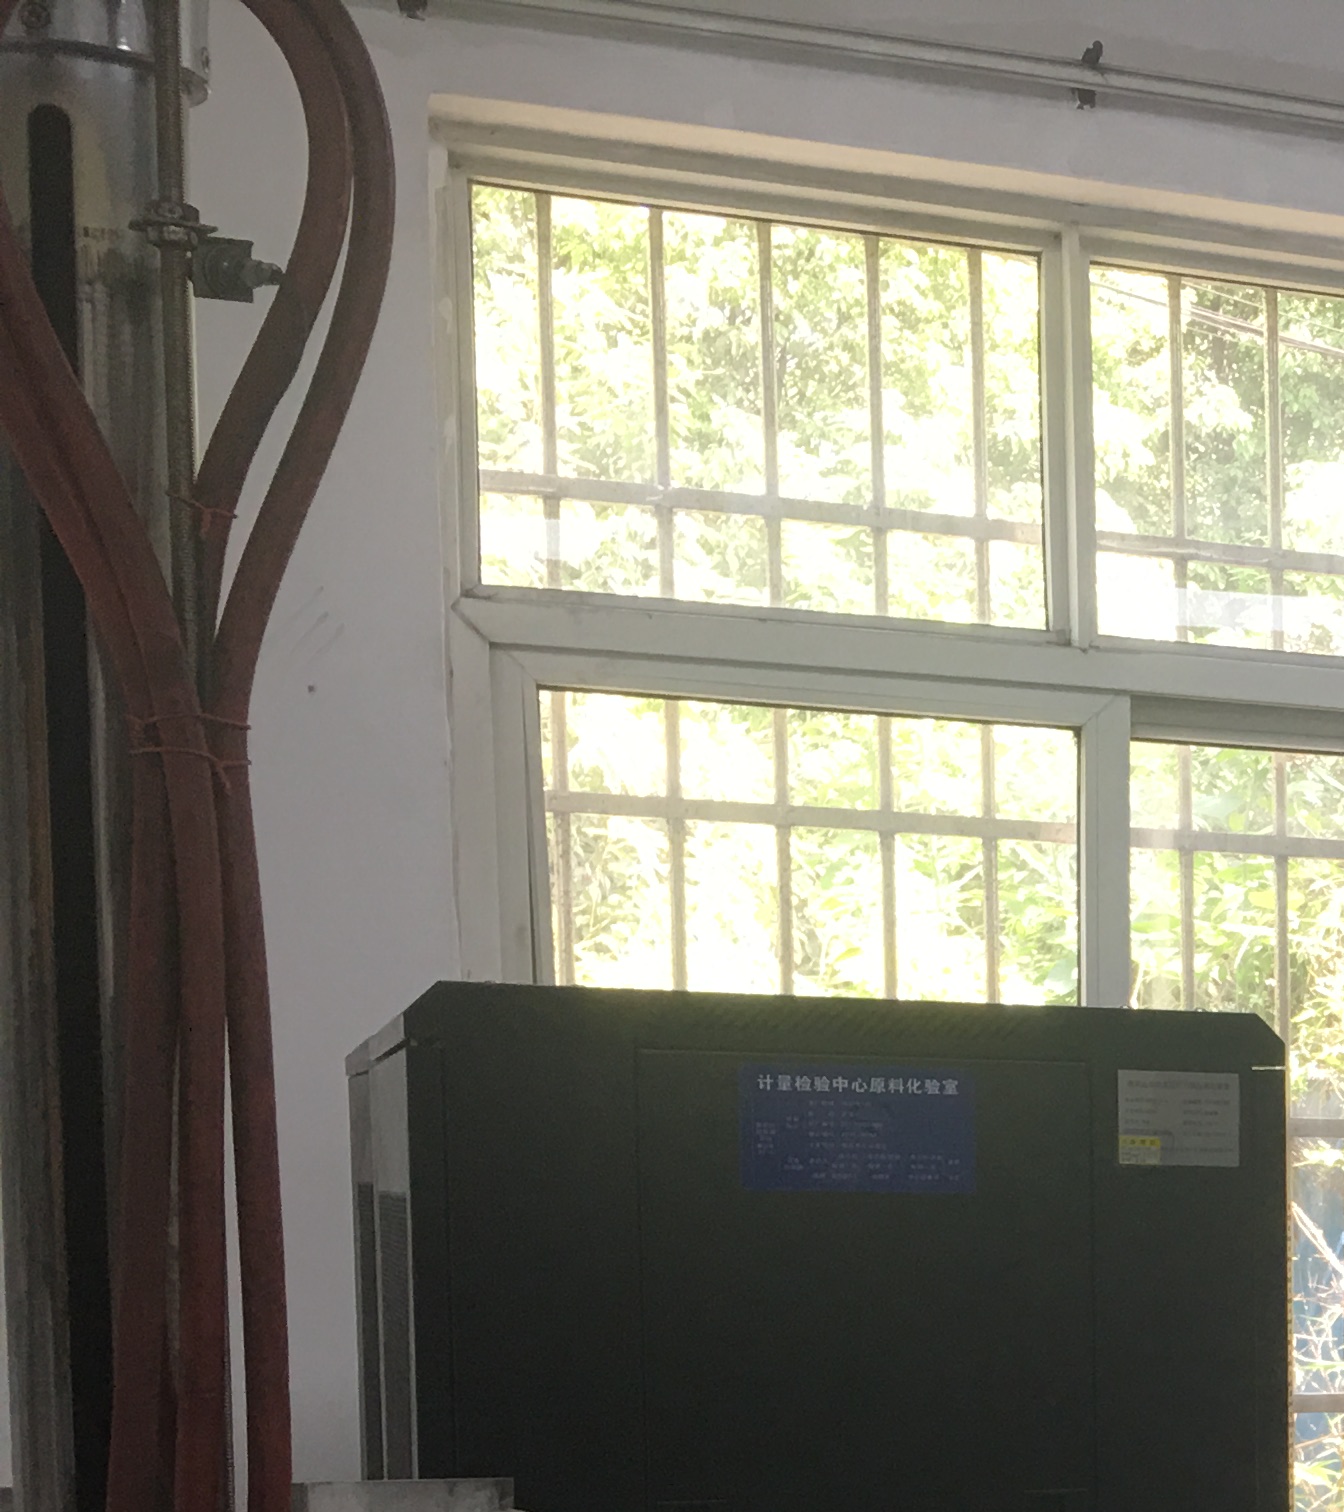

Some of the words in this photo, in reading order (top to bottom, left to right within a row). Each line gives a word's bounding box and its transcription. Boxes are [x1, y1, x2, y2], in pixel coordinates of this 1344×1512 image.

[757, 1073, 960, 1096] 计量检验中心原料化验室
